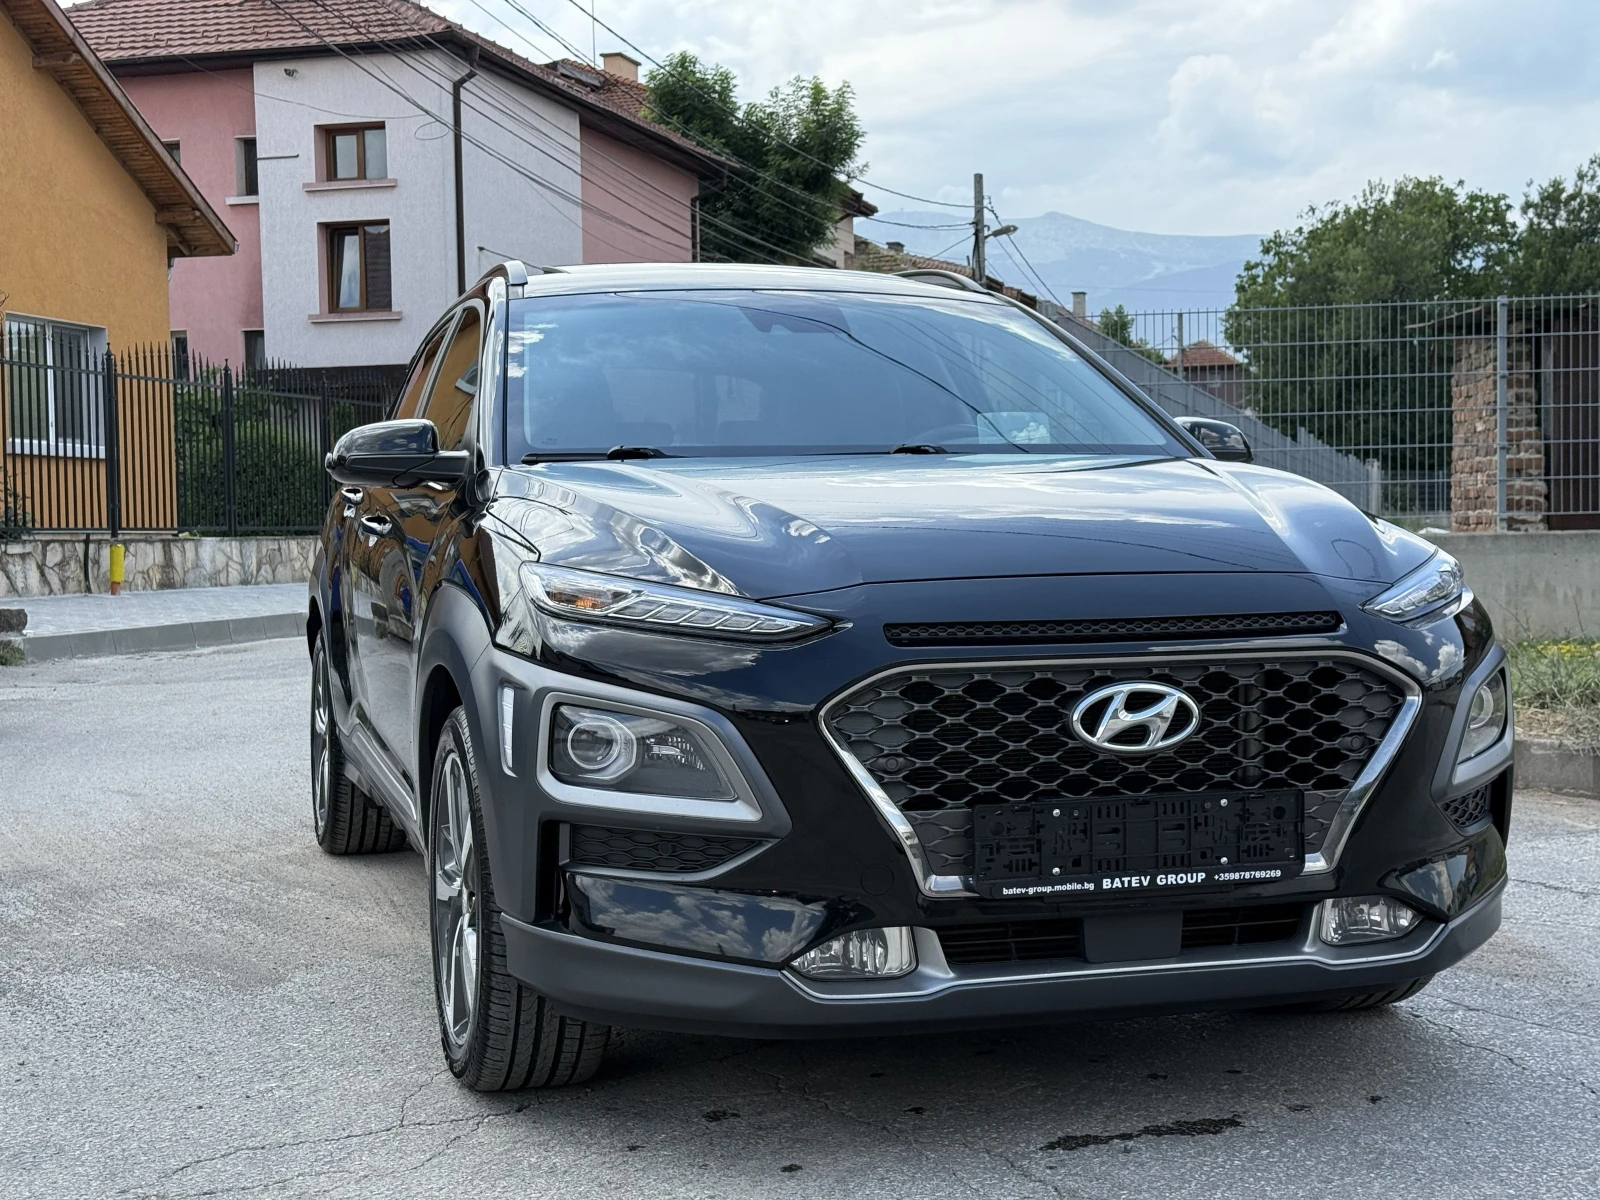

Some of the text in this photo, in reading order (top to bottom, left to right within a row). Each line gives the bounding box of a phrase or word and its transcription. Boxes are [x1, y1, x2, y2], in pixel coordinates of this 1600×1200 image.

[1002, 869, 1282, 895] batev-group.mobile.bg BATEV GROUP +359878769269
